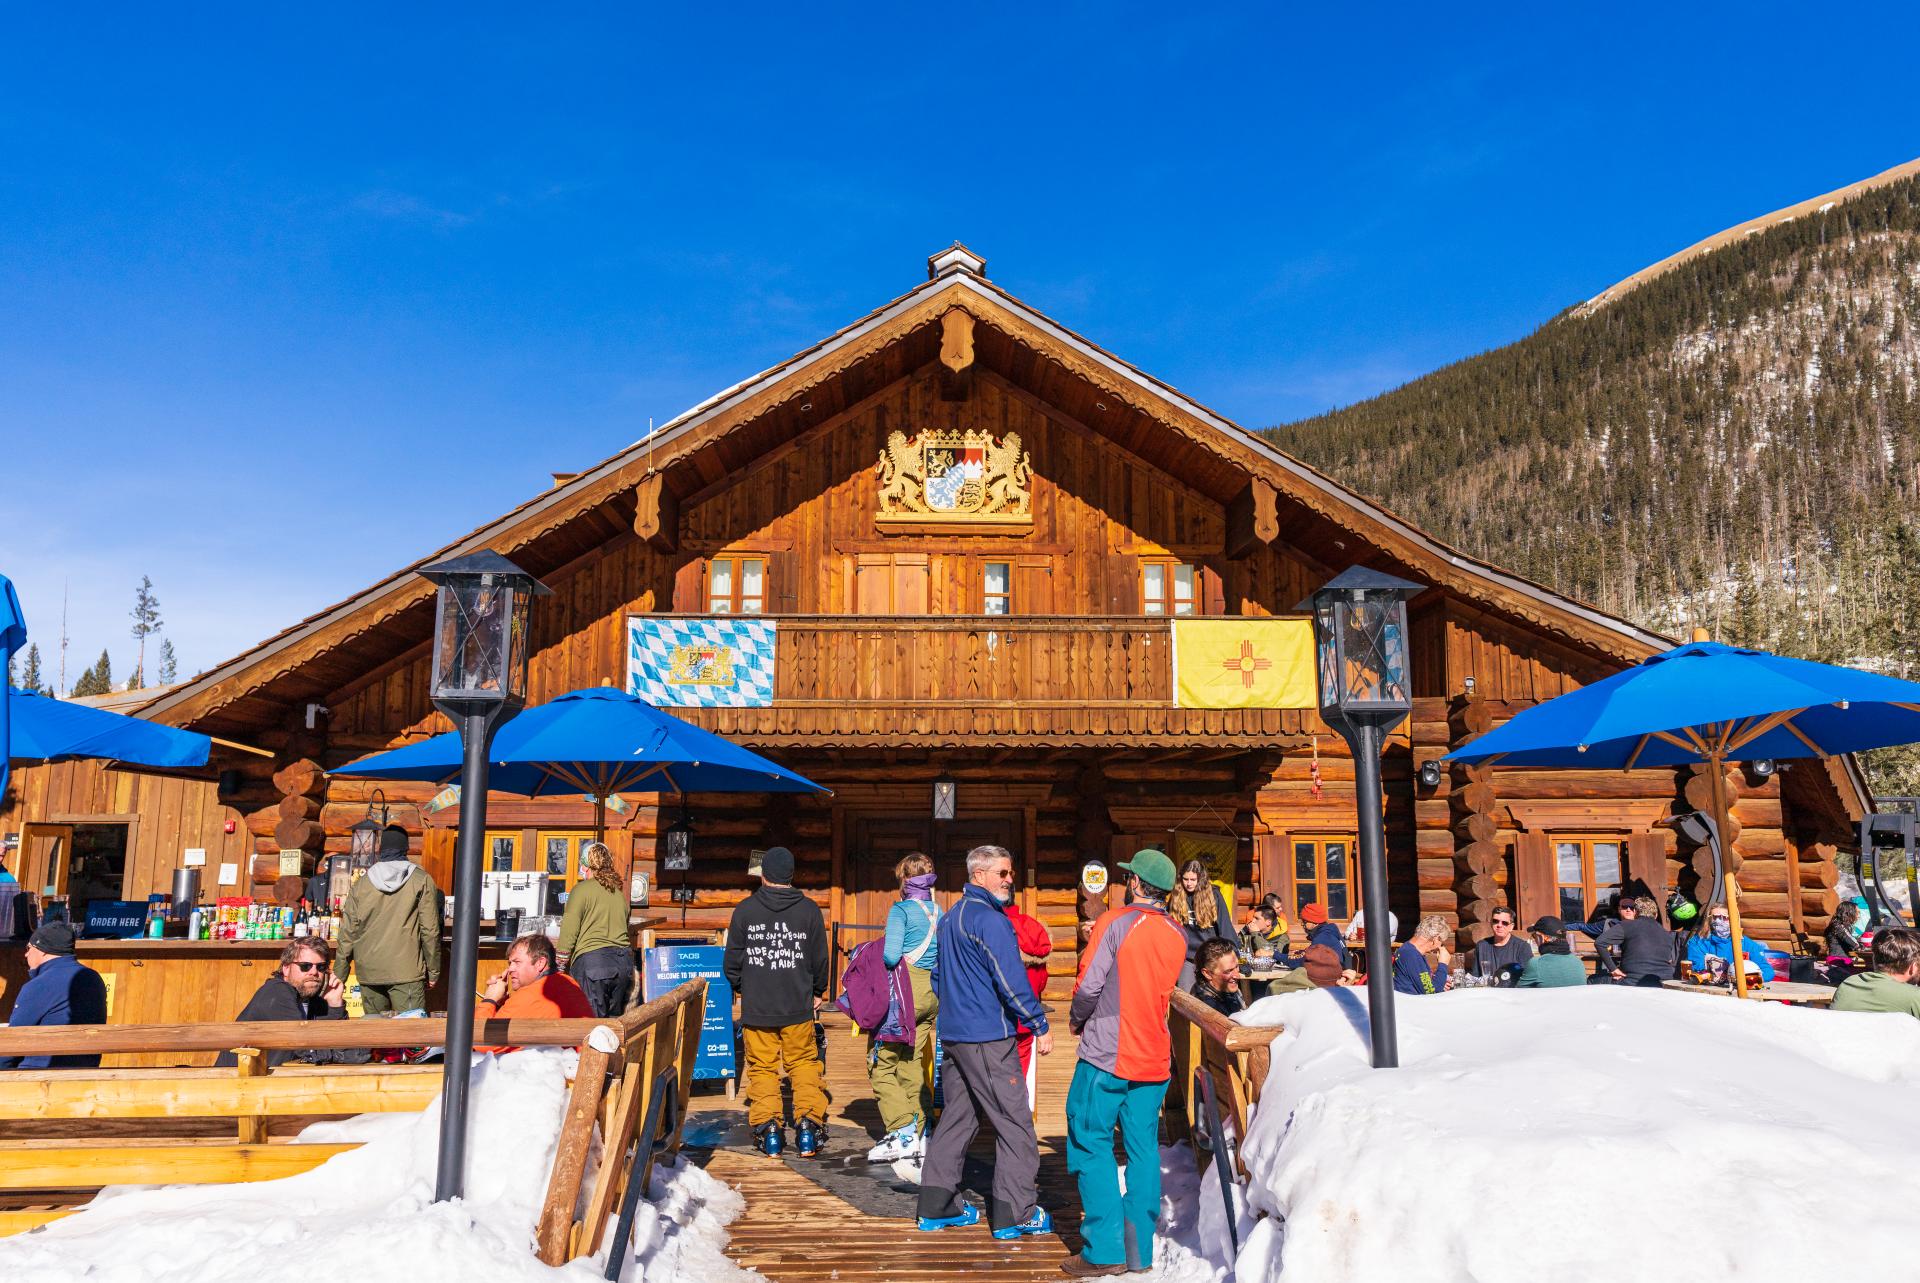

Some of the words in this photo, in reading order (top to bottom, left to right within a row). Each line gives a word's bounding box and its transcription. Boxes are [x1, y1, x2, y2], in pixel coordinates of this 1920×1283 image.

[90, 917, 118, 927] ORDER
[119, 917, 141, 927] HERE
[747, 923, 767, 933] RIDE
[747, 933, 765, 941] RIDE
[746, 946, 768, 957] RIDE
[778, 958, 796, 969] RIDE
[656, 972, 680, 980] WELCOME
[688, 971, 698, 979] THE
